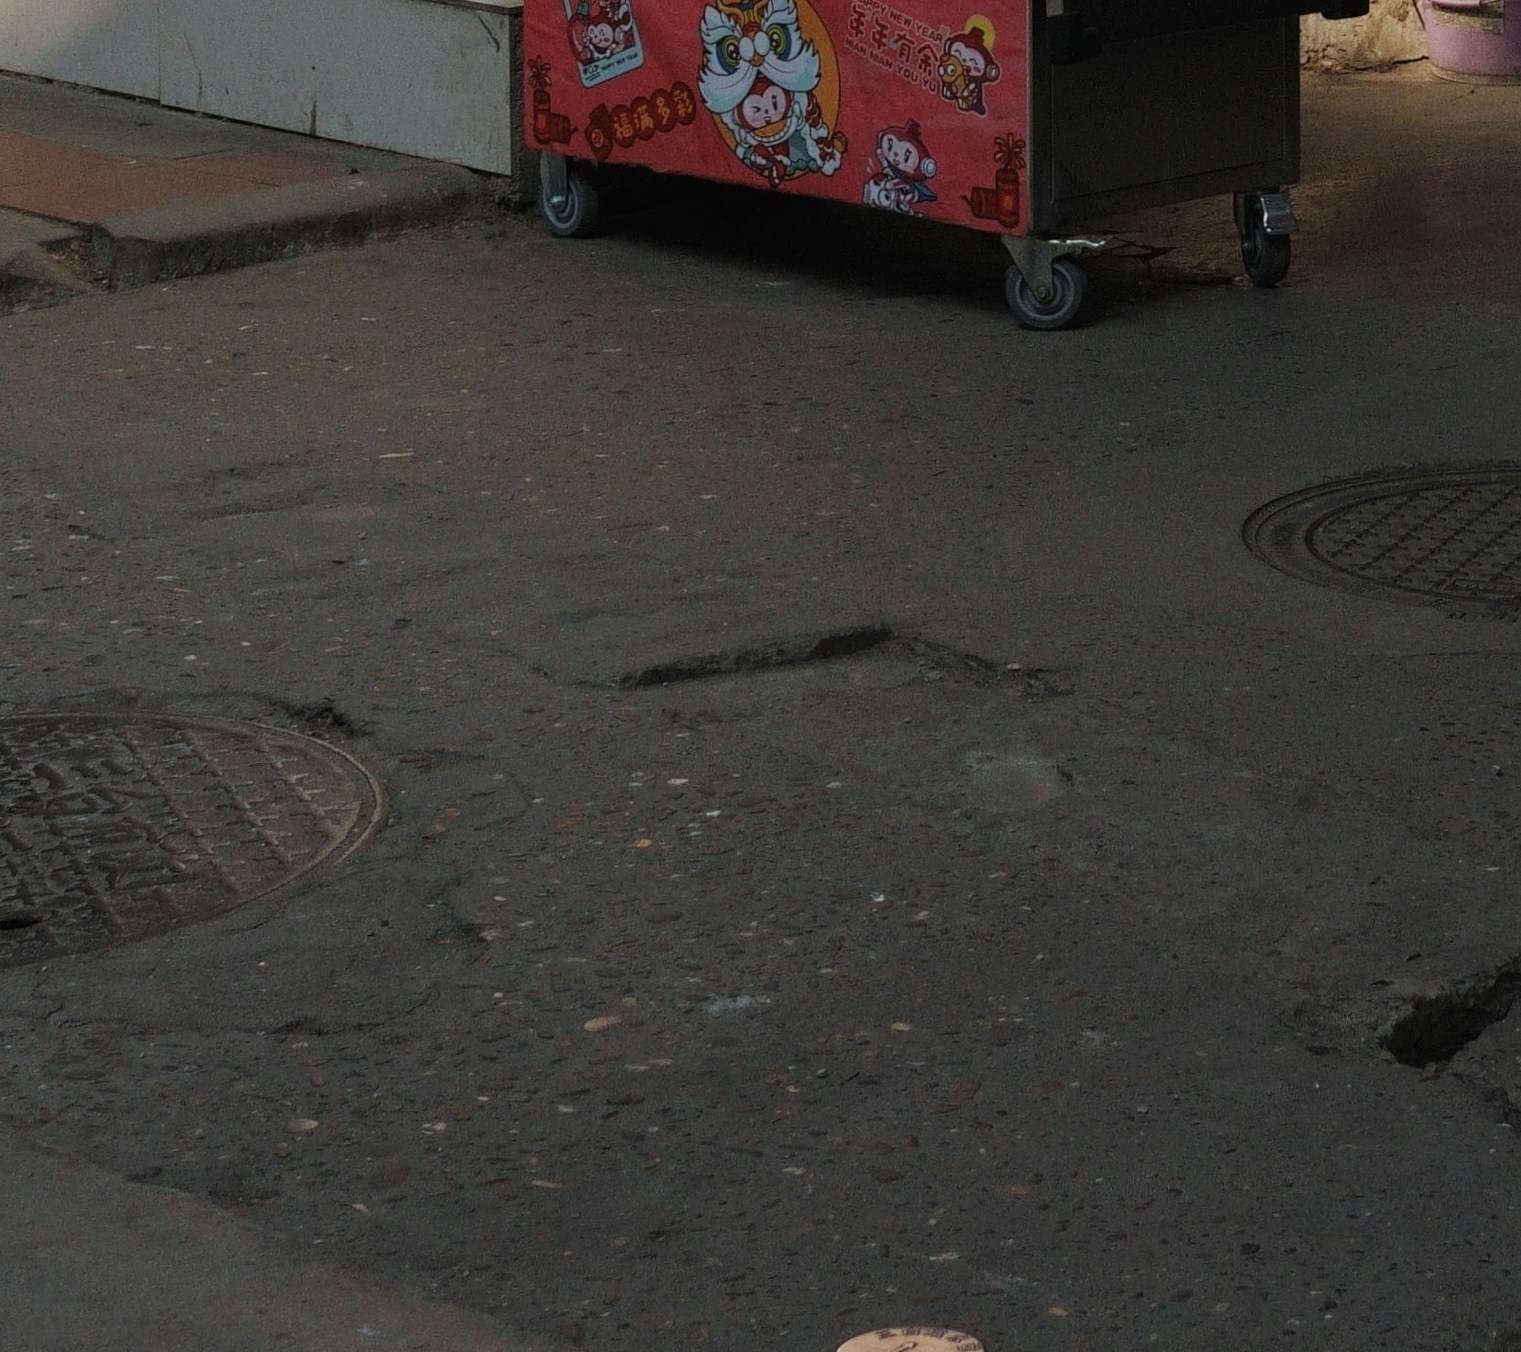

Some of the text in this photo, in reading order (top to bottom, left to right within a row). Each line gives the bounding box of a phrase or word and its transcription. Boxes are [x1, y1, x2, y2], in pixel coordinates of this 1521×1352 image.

[849, 3, 939, 77] 年年有余
[889, 9, 912, 29] NEW
[914, 21, 944, 45] YEAR
[844, 36, 937, 93] NIAN NIAN YOU YU
[614, 88, 694, 140] 福满多彩
